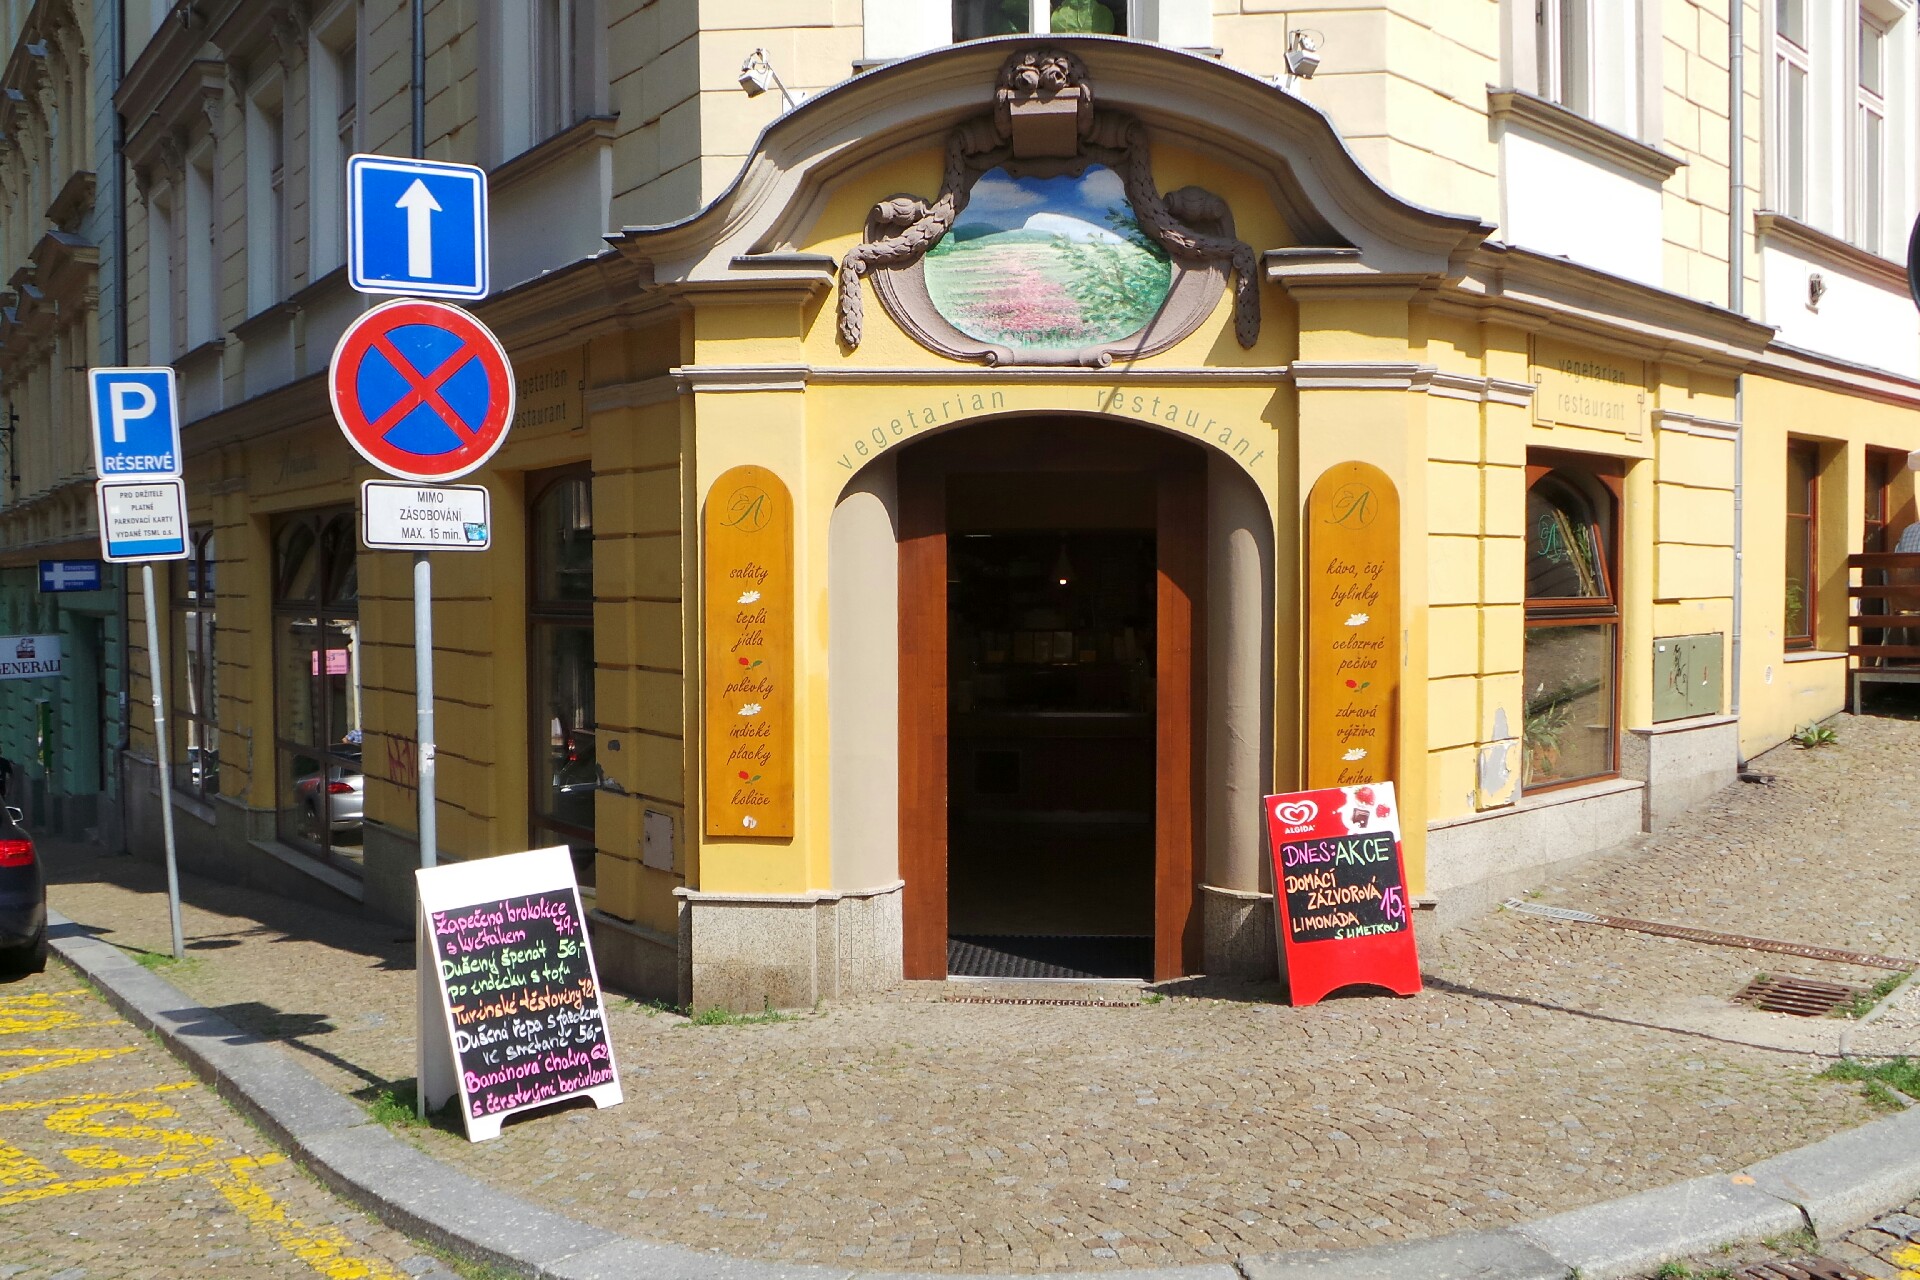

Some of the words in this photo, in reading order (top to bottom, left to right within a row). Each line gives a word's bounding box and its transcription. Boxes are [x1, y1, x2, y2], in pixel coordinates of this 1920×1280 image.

[516, 368, 567, 400] egetarian
[1558, 359, 1626, 387] vegetarian
[110, 382, 157, 442] P
[516, 400, 566, 429] estaurant
[1558, 393, 1625, 421] restaurant
[837, 391, 1005, 470] vegetarian
[1097, 389, 1264, 467] restaurant
[104, 452, 174, 470] RÉSERVÉ
[135, 490, 163, 498] DRŽITELE
[417, 491, 444, 503] MIMO
[131, 502, 154, 511] PLATNÉ
[400, 506, 462, 522] ZÁSOBOVÁNÍ
[115, 515, 150, 524] PARKOVACÍ
[116, 529, 142, 538] VYDANÉ
[401, 527, 425, 539] MAX.
[429, 528, 440, 539] 15
[443, 529, 461, 540] min.
[729, 562, 769, 586] saláty
[1326, 558, 1358, 578] káva,
[1364, 560, 1385, 580] čaj
[1331, 583, 1380, 607] bylinky
[736, 608, 767, 630] teplá
[731, 629, 764, 653] jídla
[1332, 632, 1385, 650] celozrné
[1336, 656, 1378, 676] pečivo
[723, 677, 774, 699] polévky
[1335, 702, 1378, 718] zdravá
[729, 721, 771, 738] indické
[1336, 724, 1376, 744] výživa
[727, 743, 772, 766] placky
[731, 789, 771, 805] koláče
[1285, 825, 1315, 834] ALGIDA
[1336, 838, 1390, 866] AKCE
[1285, 868, 1336, 894] DOMÁCÍ
[1308, 876, 1382, 911] ZÁZVOROVÁ
[505, 897, 567, 923] brokolice
[1293, 908, 1360, 933] LIMONÁDA
[447, 942, 457, 955] s
[458, 929, 526, 953] květákem
[1335, 928, 1344, 940] S
[1346, 922, 1399, 939] LIMETKOU
[441, 951, 499, 980] Dušený
[501, 940, 547, 969] špenát
[448, 985, 467, 1003] po
[471, 969, 527, 995] indicku
[531, 970, 540, 983] s
[543, 961, 571, 985] tofu
[451, 992, 518, 1026] Turinské
[520, 985, 582, 1010] těstoviny
[455, 1021, 508, 1054] Dušená
[512, 1018, 543, 1041] řepa
[547, 1014, 556, 1029] s
[464, 1055, 542, 1094] Banánová
[545, 1045, 590, 1073] chalva
[472, 1101, 483, 1117] s
